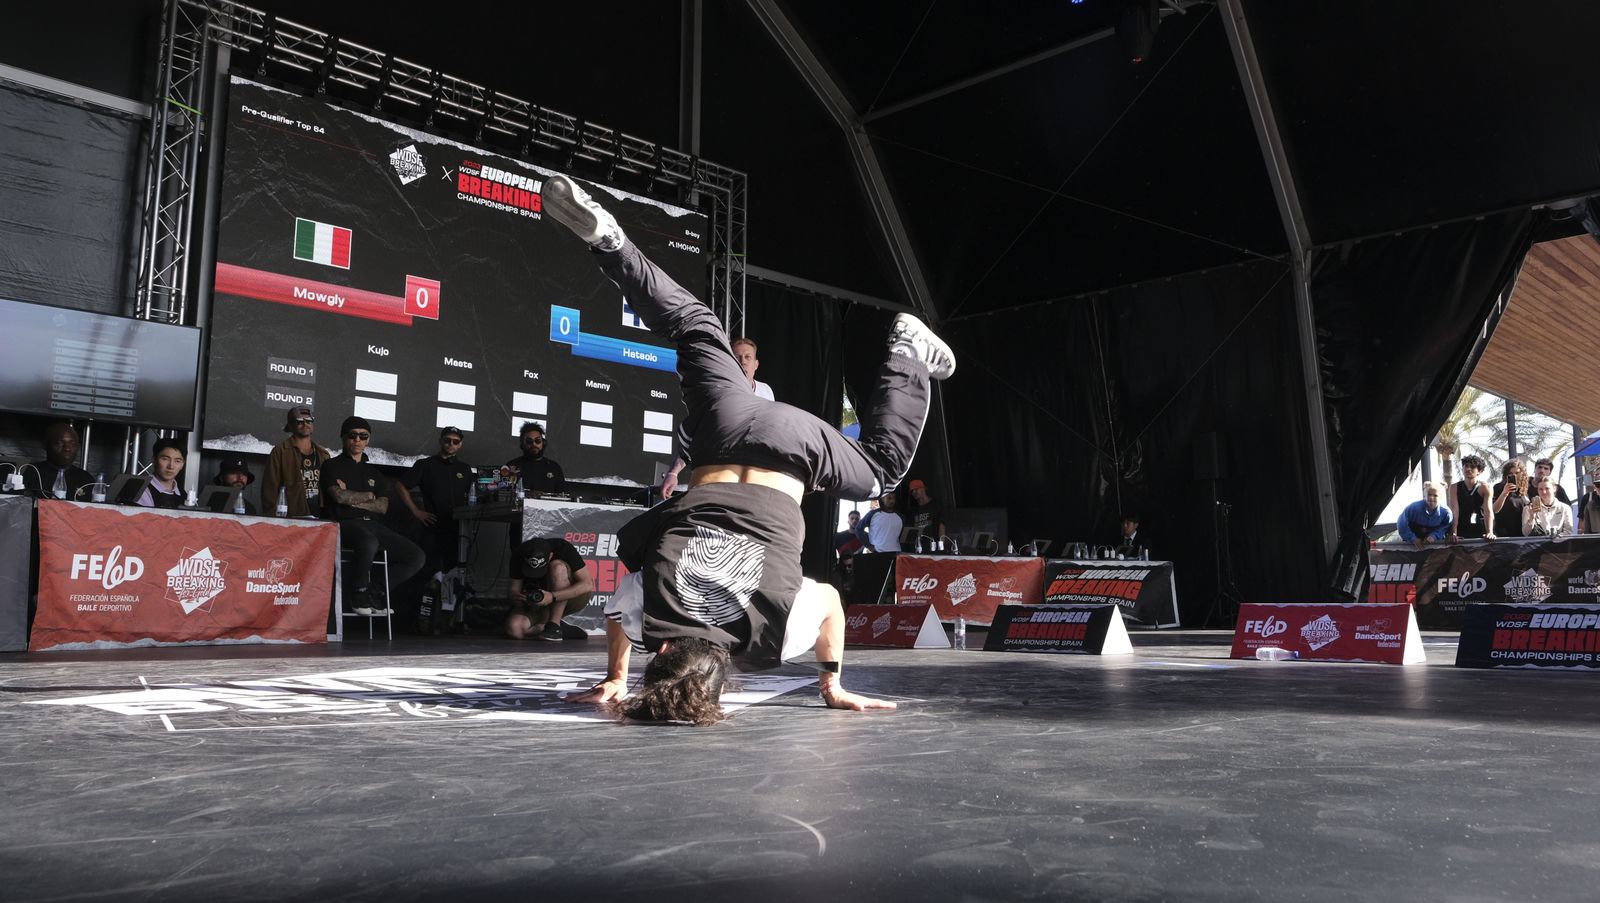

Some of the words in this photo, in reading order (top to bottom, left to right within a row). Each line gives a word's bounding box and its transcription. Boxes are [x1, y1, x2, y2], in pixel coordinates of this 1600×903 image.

[241, 105, 295, 126] Pre-Qualifier
[296, 120, 312, 131] Top
[313, 125, 325, 134] 64
[396, 147, 422, 165] WDSF
[459, 165, 480, 176] WDSF
[480, 165, 543, 194] EUROPEAN
[457, 172, 543, 214] BREAKING
[457, 192, 519, 215] CHAMPIONSHIPS
[520, 209, 542, 220] SPAIN
[293, 286, 345, 308] Mowgly
[415, 288, 429, 309] 0
[559, 316, 571, 335] 0
[367, 344, 389, 356] Kujo
[270, 363, 306, 376] ROUND
[308, 368, 315, 377] 1
[524, 369, 539, 380] Fox
[585, 379, 611, 392] Manny
[266, 391, 304, 404] ROUND
[305, 397, 313, 405] 2
[564, 532, 597, 543] 2023
[179, 558, 221, 577] WDSF
[247, 567, 265, 579] world
[1077, 569, 1151, 581] EUROPEAN
[1511, 575, 1545, 588] WDSF
[167, 576, 225, 589] BREAKING
[245, 581, 301, 596] DanceSport
[1046, 579, 1143, 600] BREAKING
[1504, 587, 1551, 595] BREAKING
[1107, 597, 1136, 608] SPAIN
[1029, 611, 1093, 622] EUROPEAN
[1308, 620, 1337, 631] WDSF
[1494, 620, 1528, 628] WDSF
[1007, 622, 1089, 641] BREAKING
[1354, 632, 1402, 641] DanceSport
[1003, 638, 1060, 646] CHAMPIONSHIPS
[1490, 650, 1593, 661] CHAMPIONSHIPS
